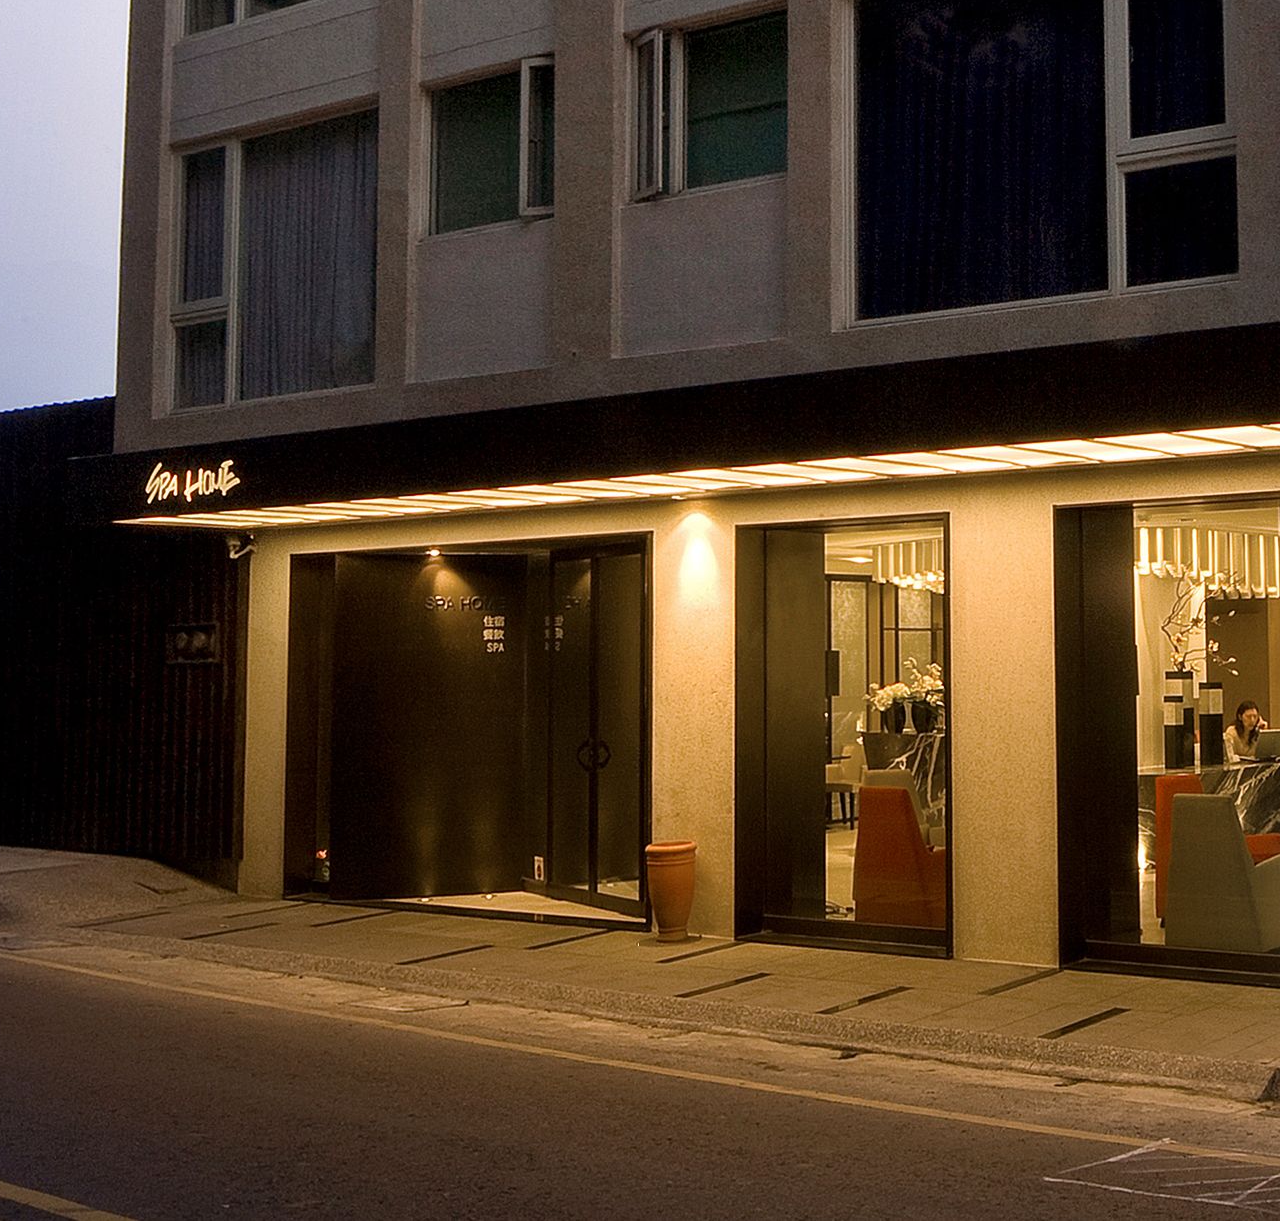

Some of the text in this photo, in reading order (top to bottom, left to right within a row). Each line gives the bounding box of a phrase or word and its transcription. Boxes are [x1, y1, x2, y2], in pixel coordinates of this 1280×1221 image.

[145, 459, 241, 505] SPA HOME
[424, 595, 456, 611] SPA
[486, 642, 505, 653] SPA
